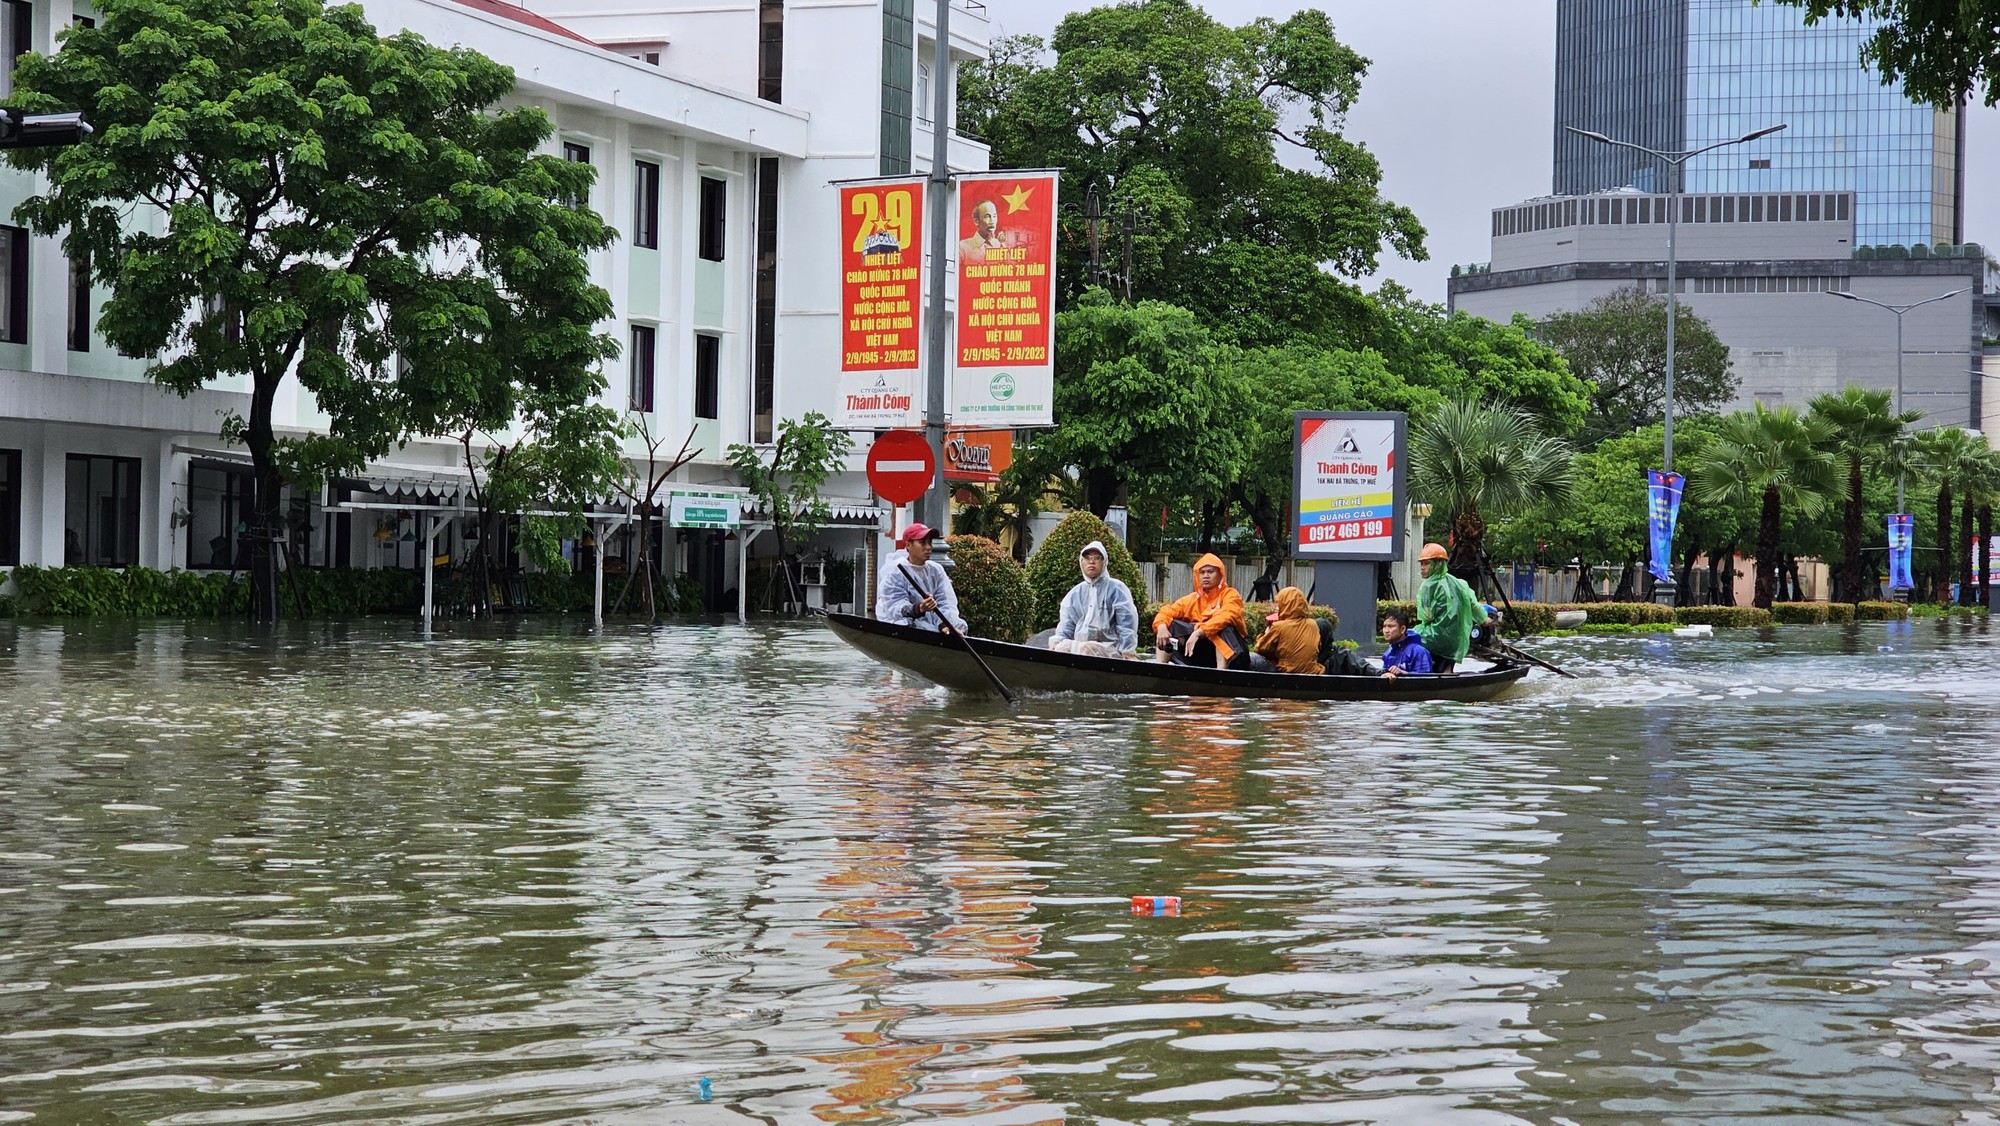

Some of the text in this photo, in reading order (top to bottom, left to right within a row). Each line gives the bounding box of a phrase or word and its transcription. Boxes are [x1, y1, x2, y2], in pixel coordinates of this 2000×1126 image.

[865, 251, 902, 267] NHIỆT LIỆT
[985, 246, 1026, 261] NHIỆT LIỆT
[847, 267, 917, 284] CHÀO MỪNG 78 NĂM
[966, 263, 1045, 278] CHÀO MỪNG 78 NĂM
[860, 283, 906, 300] QUỐC KHÁNH
[980, 278, 1031, 294] QUỐC KHÁNH
[854, 299, 910, 316] NƯỚC CỘNG HÒA
[972, 295, 1037, 311] NƯỚC CỘNG HÒA
[862, 317, 874, 332] HỘI
[876, 316, 891, 330] CHỦ
[981, 313, 995, 327] HỘI
[997, 311, 1013, 325] CHỦ
[1015, 312, 1040, 325] NGHĨA
[866, 333, 898, 348] VIỆT NAM
[986, 329, 1022, 344] VIỆT NAM
[846, 352, 878, 364] 2/9/1945
[963, 348, 1000, 361] 2/9/1945
[1007, 347, 1045, 360] 2/9/2023
[846, 394, 880, 410] Thành
[1317, 462, 1378, 476] Thành Công
[1331, 497, 1362, 507] LIÊN HỆ
[1320, 510, 1373, 522] QUẢNG CÁO
[1309, 520, 1383, 541] 0912 469 199
